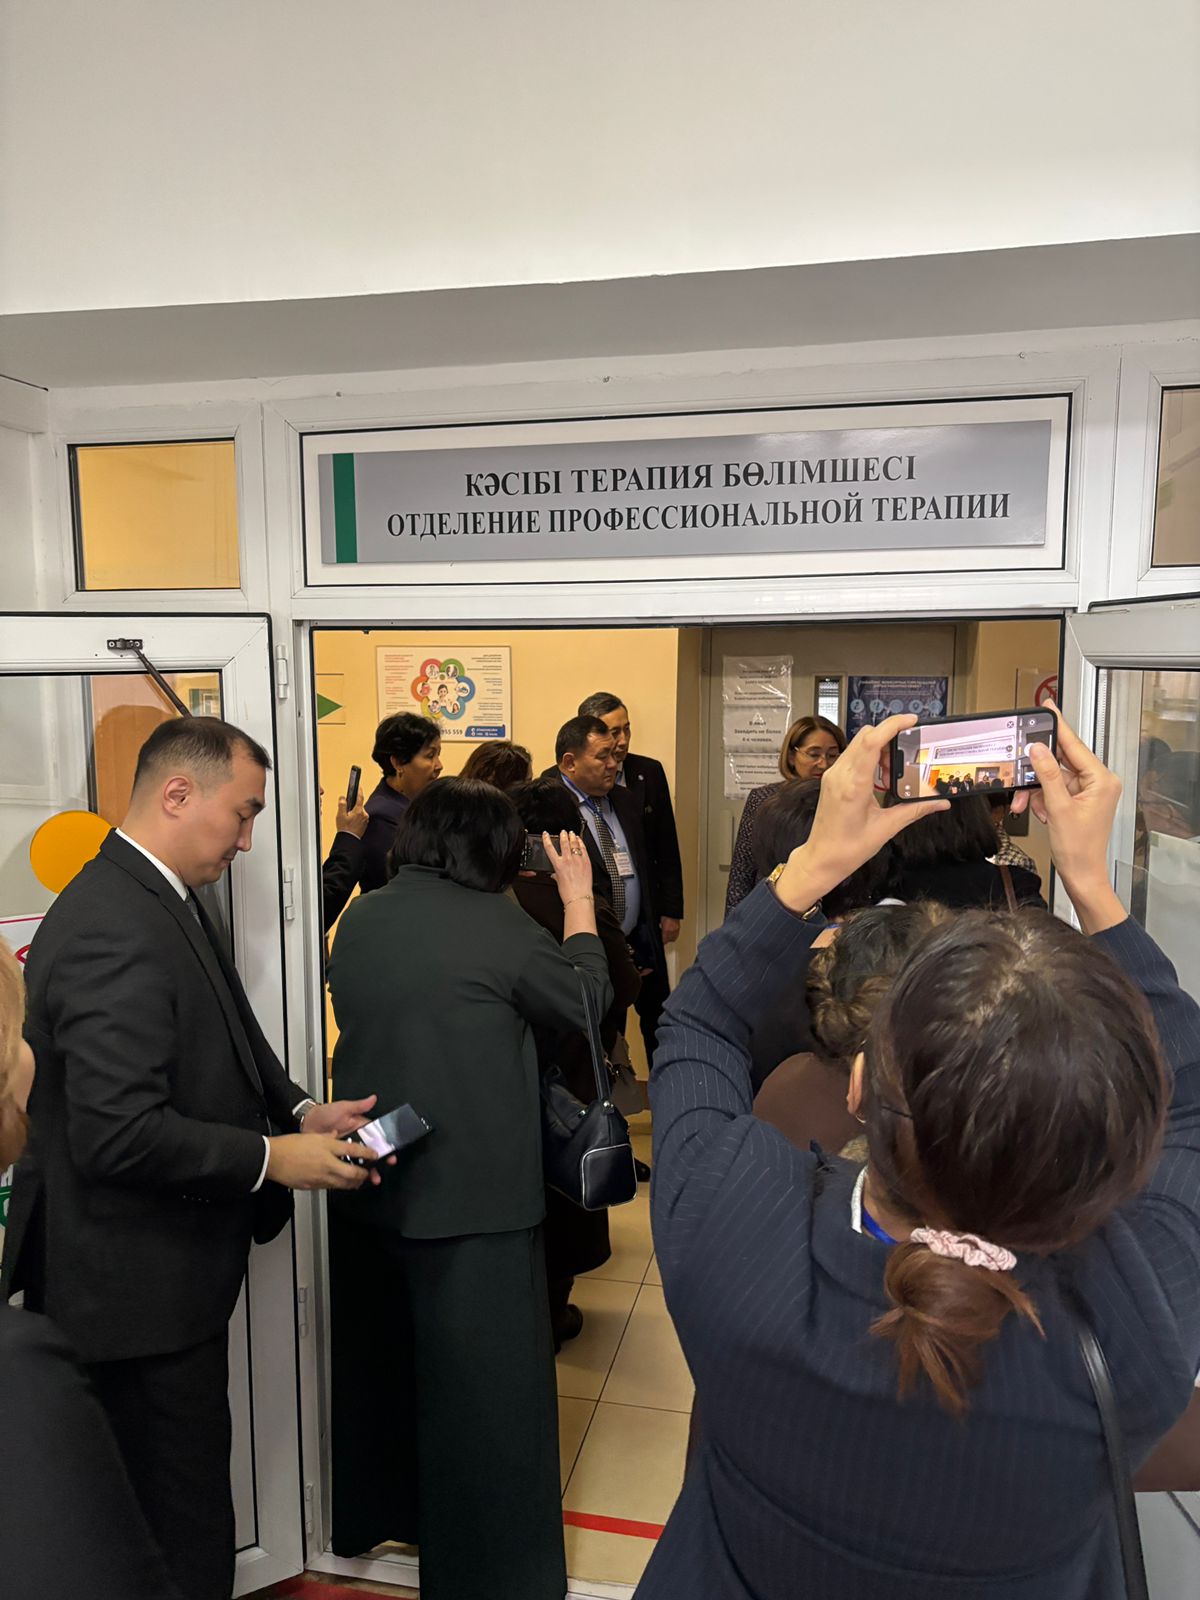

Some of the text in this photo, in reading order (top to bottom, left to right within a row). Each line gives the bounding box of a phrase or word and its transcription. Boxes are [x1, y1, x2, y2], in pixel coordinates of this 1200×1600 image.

[465, 456, 916, 497] КӘСІБІ ТЕРАПИЯ БӨЛІМШЕСІ
[387, 491, 1009, 541] ОТДЕЛЕНИЕ ПРОФЕССИОНАЛЬНОЙ ТЕРАПИИ
